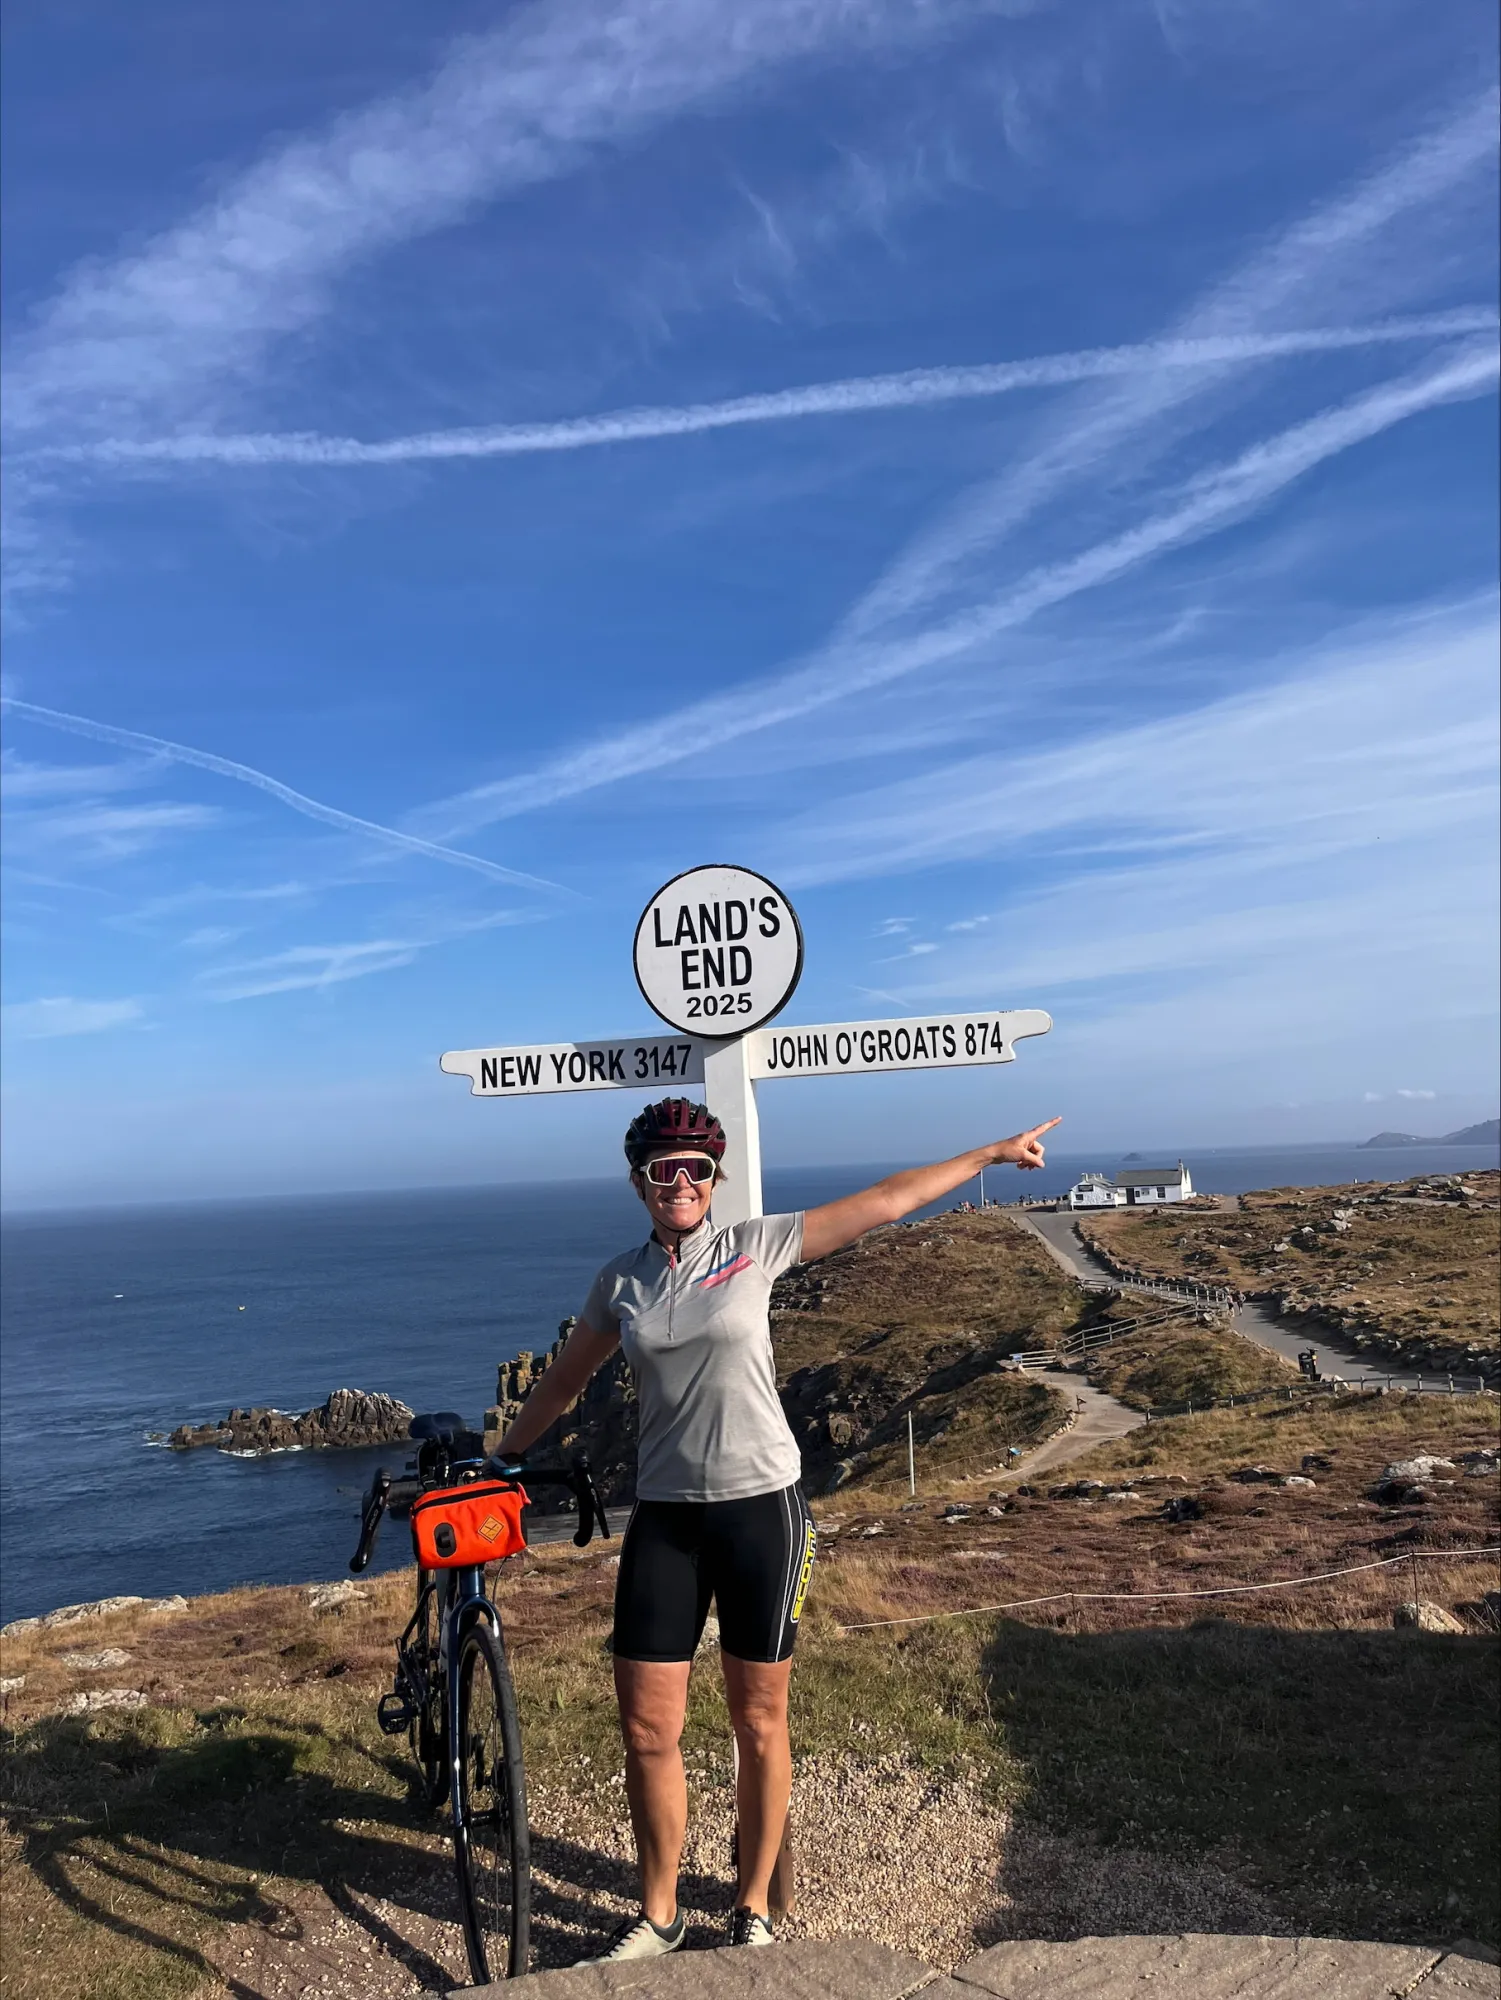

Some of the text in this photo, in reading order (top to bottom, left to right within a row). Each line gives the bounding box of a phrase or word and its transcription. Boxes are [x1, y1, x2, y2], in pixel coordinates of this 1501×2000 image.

[653, 896, 781, 948] LAND'S
[681, 945, 753, 991] END
[686, 992, 753, 1018] 2025
[481, 1044, 692, 1089] NEW YORK 3147
[767, 1021, 1003, 1070] JOHN O'GROATS 874
